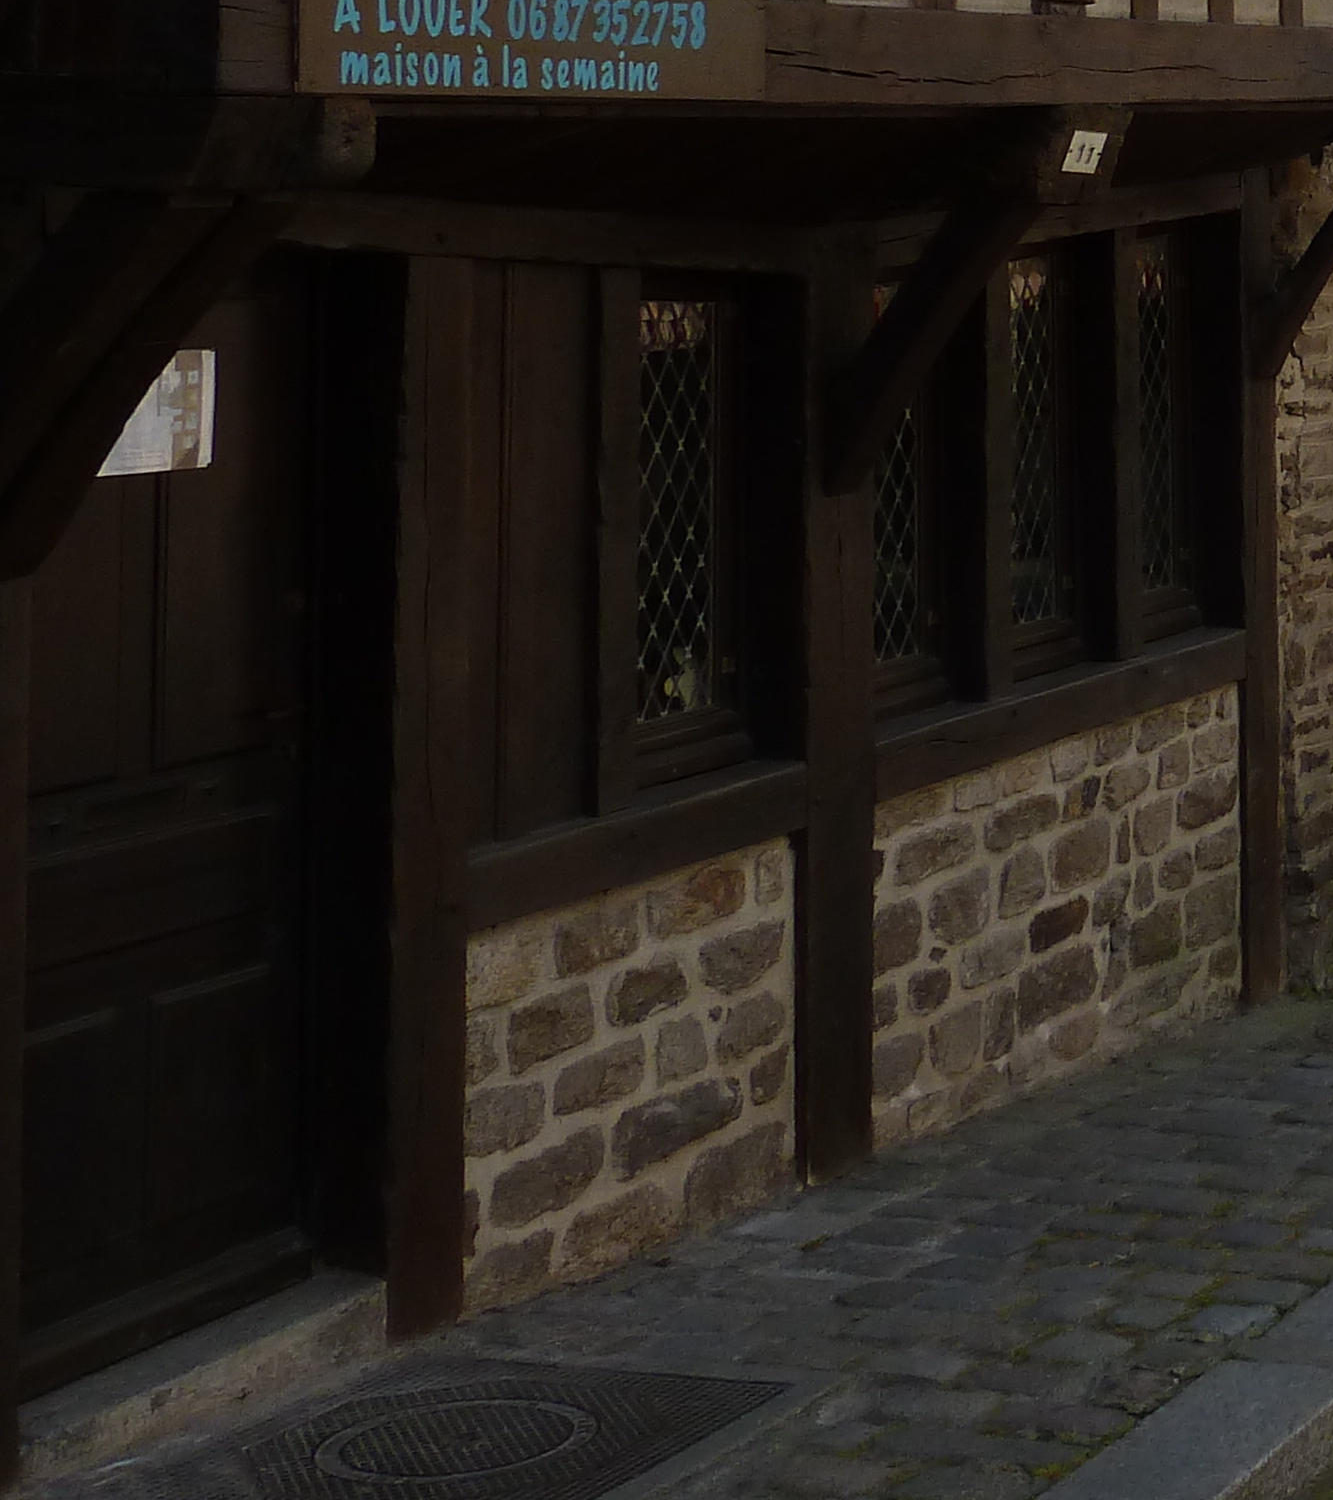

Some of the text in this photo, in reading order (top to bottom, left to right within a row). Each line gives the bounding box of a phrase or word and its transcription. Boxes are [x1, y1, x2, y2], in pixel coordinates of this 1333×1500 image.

[340, 42, 659, 91] maison à la semaine
